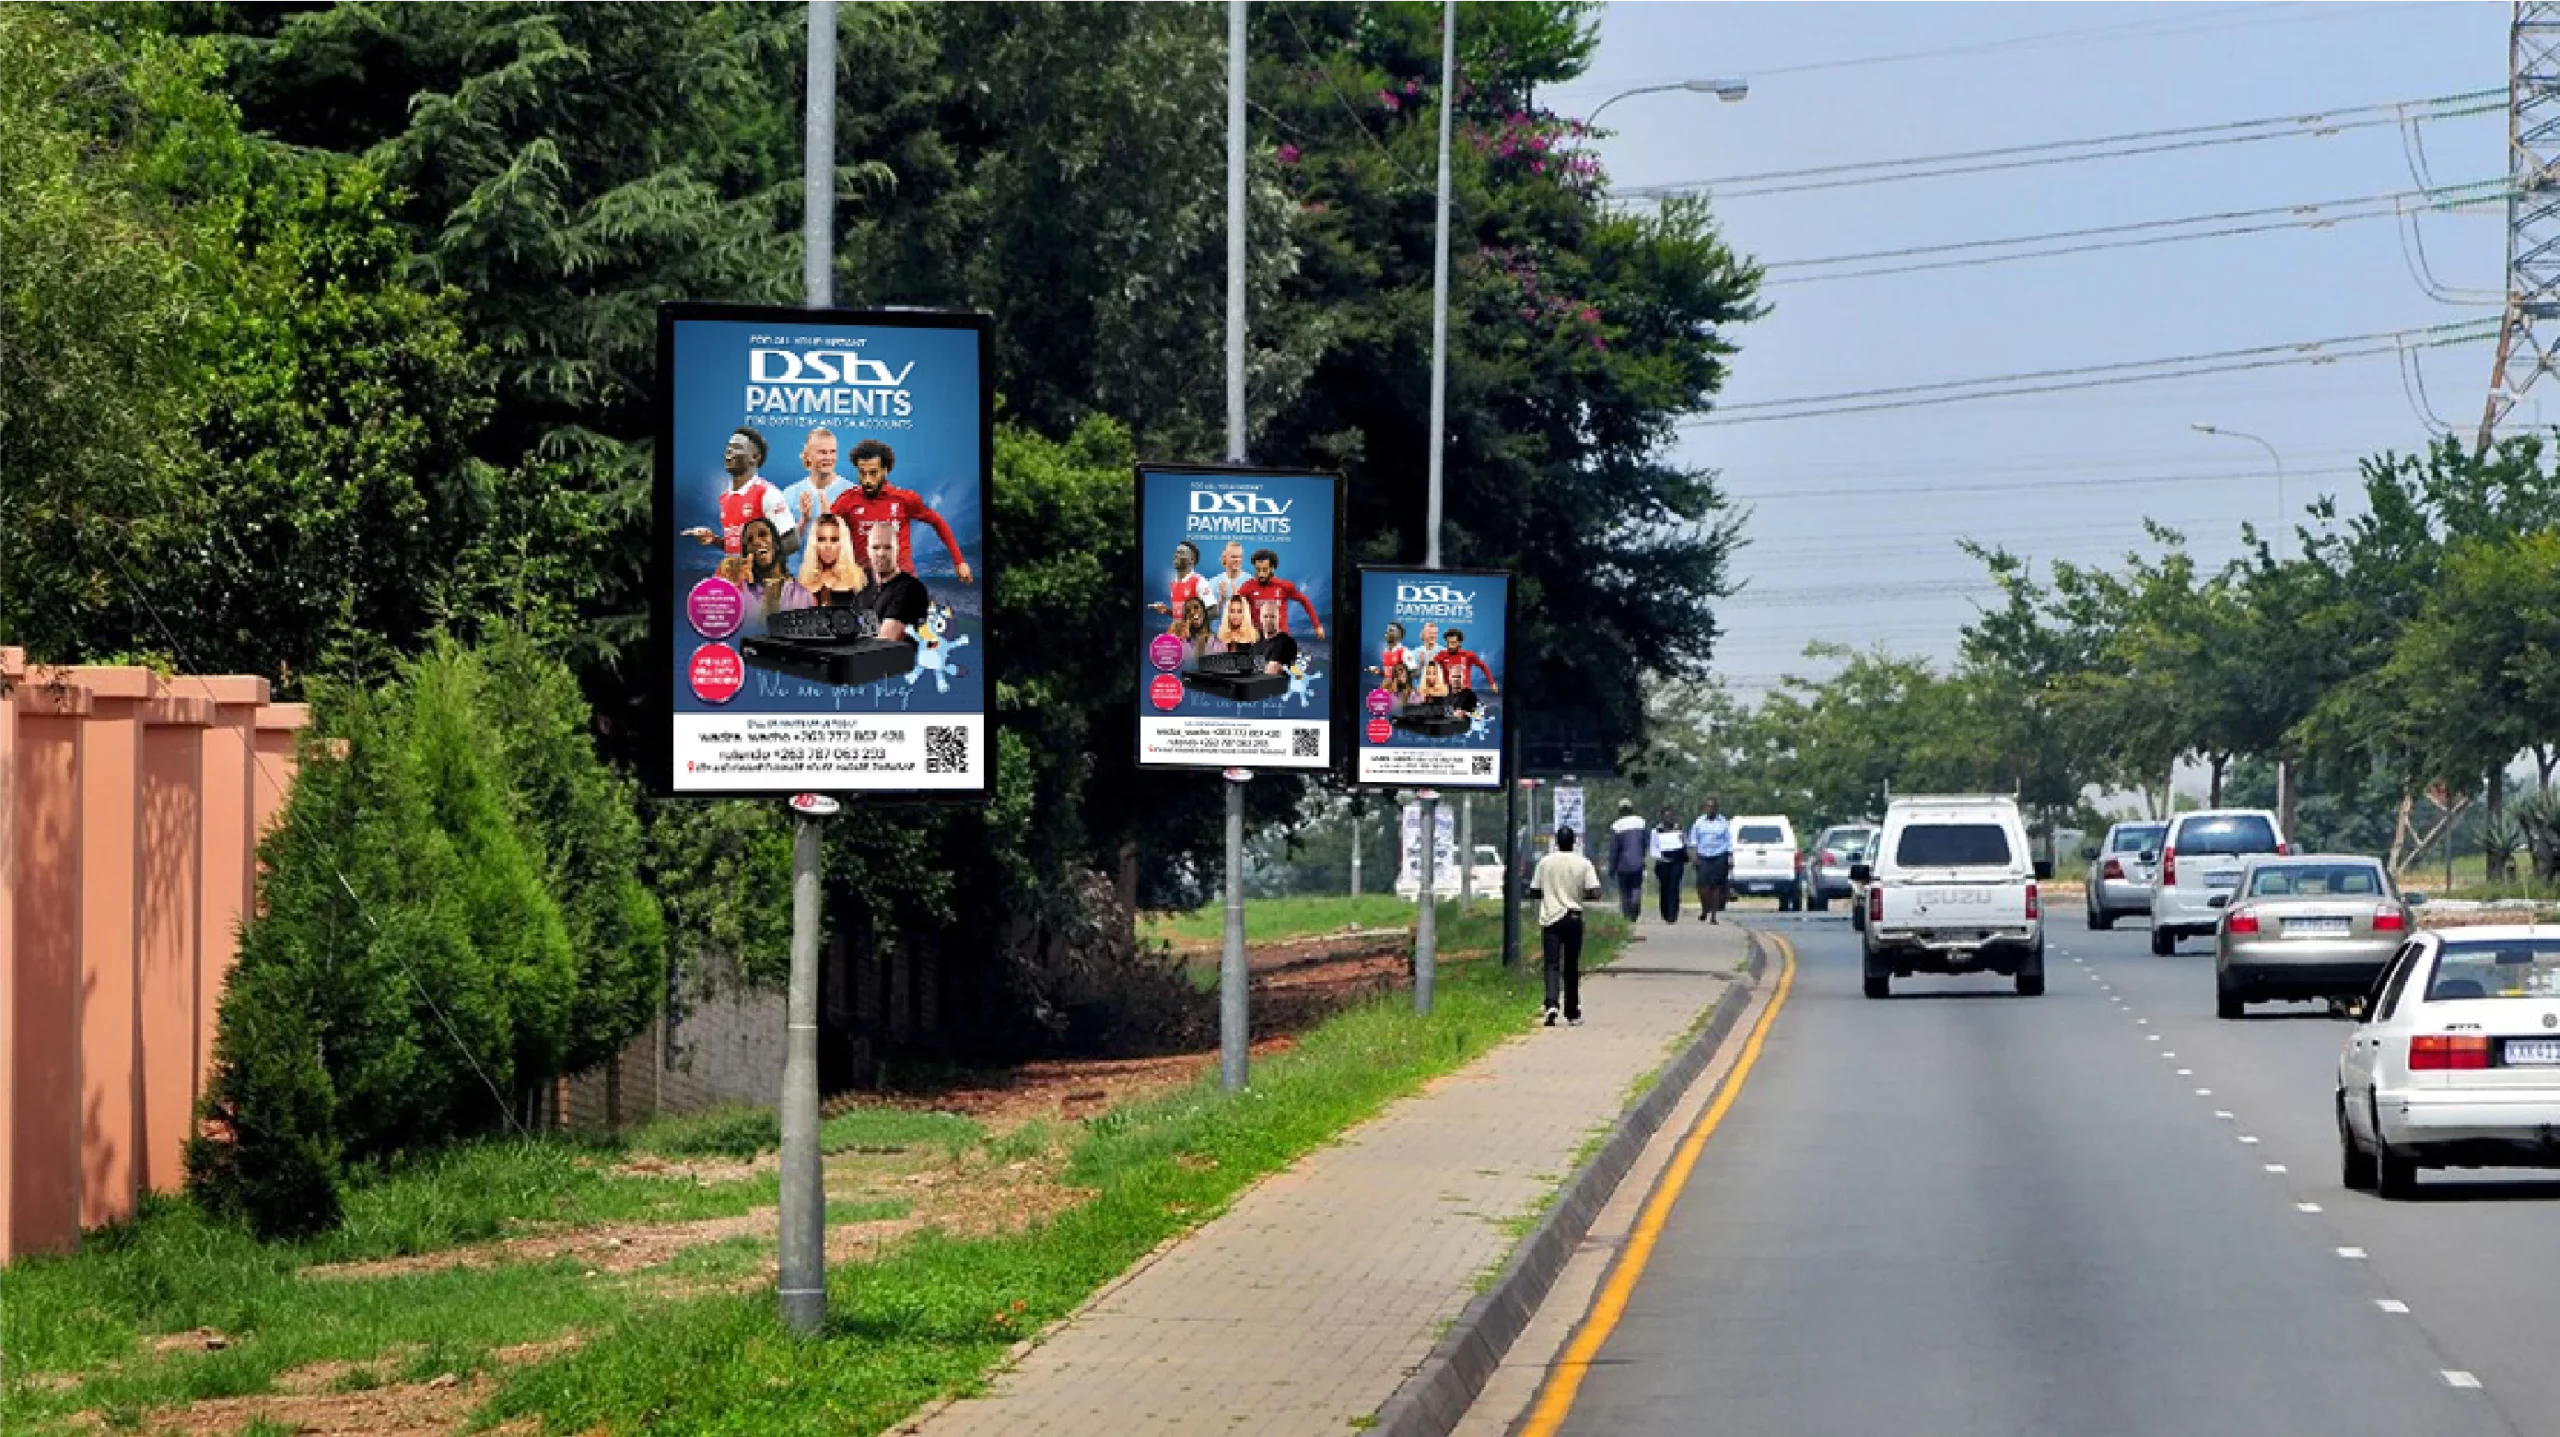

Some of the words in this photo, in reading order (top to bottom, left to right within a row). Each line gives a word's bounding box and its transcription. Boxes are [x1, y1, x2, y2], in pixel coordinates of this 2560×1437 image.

[750, 348, 915, 386] DStv
[746, 386, 914, 416] PAYMENTS
[1190, 490, 1293, 515] DStv
[1187, 515, 1292, 534] PAYMENTS
[1397, 585, 1477, 604] DStv
[1396, 603, 1473, 618] PAYMENTS
[1916, 888, 1992, 905] ISUZU
